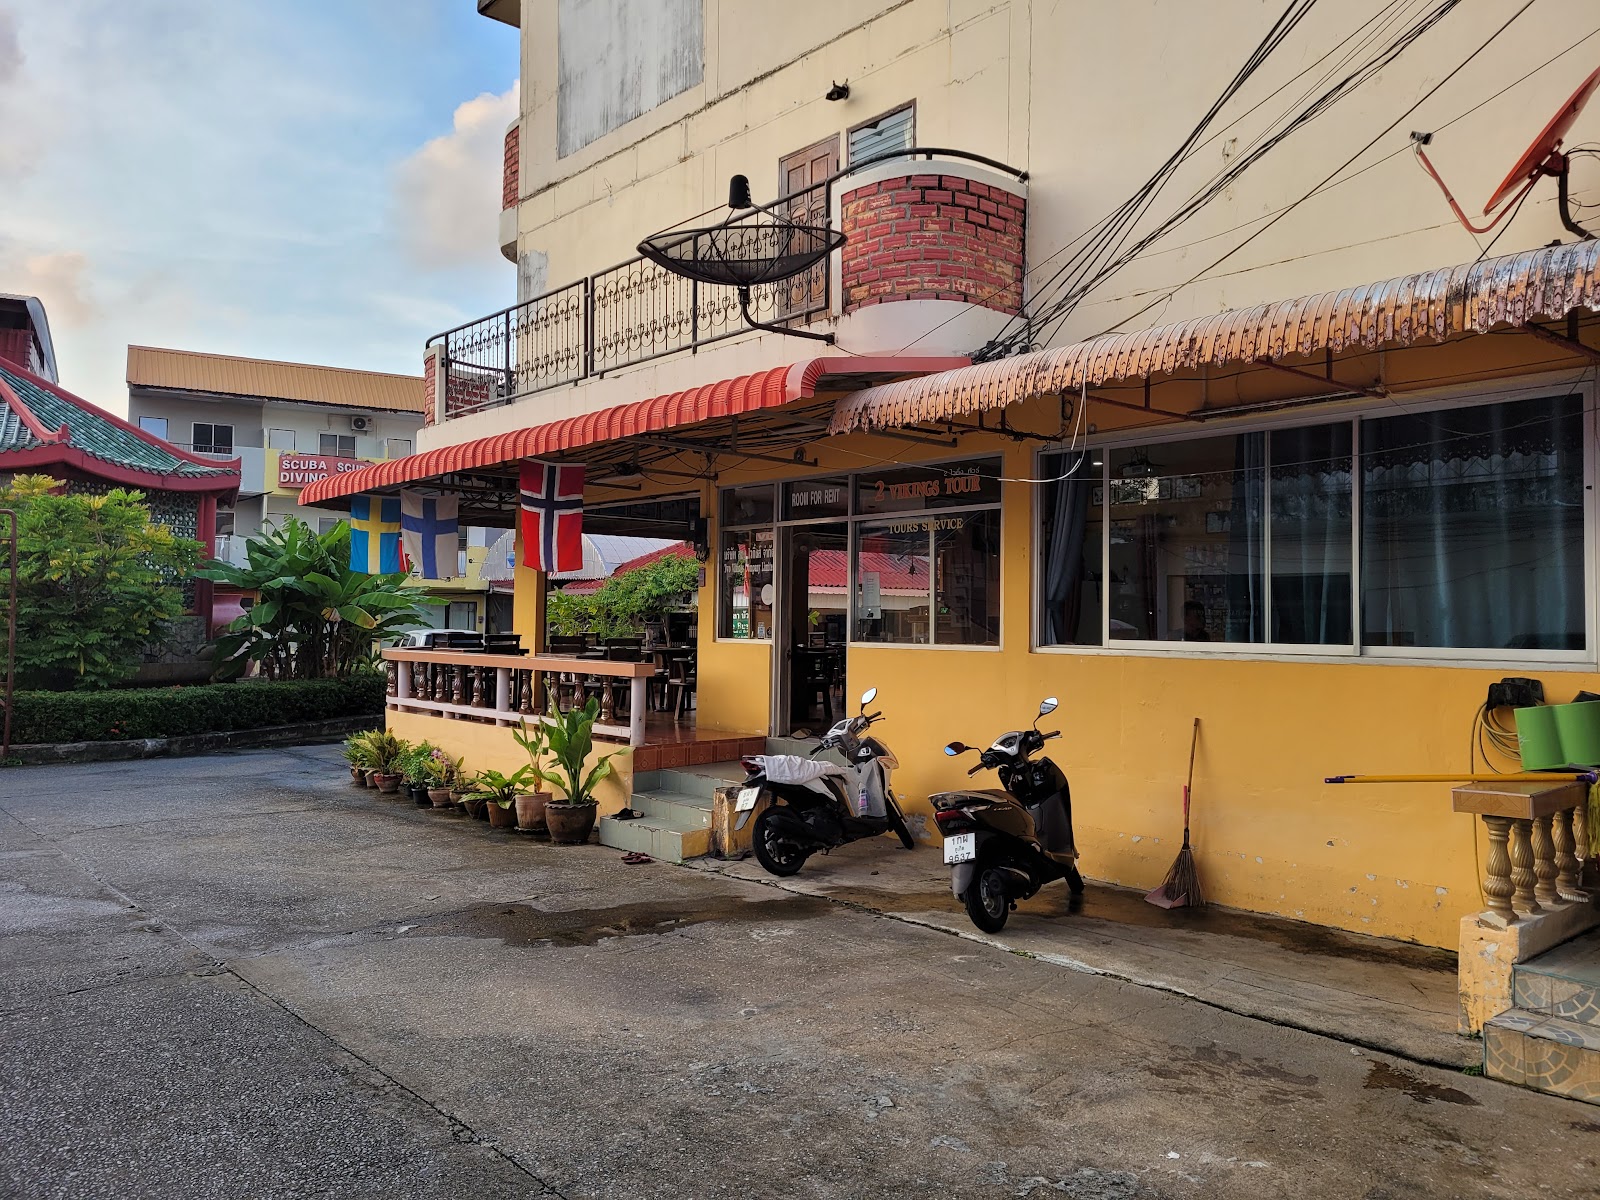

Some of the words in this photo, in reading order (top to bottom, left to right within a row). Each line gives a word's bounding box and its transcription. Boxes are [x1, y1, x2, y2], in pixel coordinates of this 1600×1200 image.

[282, 460, 327, 470] SCUBA
[875, 480, 885, 501] 2
[889, 480, 939, 499] VIKINGS
[945, 475, 981, 494] TOUR
[792, 492, 808, 507] ROOM
[810, 491, 822, 505] FOR
[824, 489, 840, 503] RENT
[888, 522, 918, 534] TOURS
[922, 518, 963, 531] SERVICE
[949, 852, 971, 863] 9637
